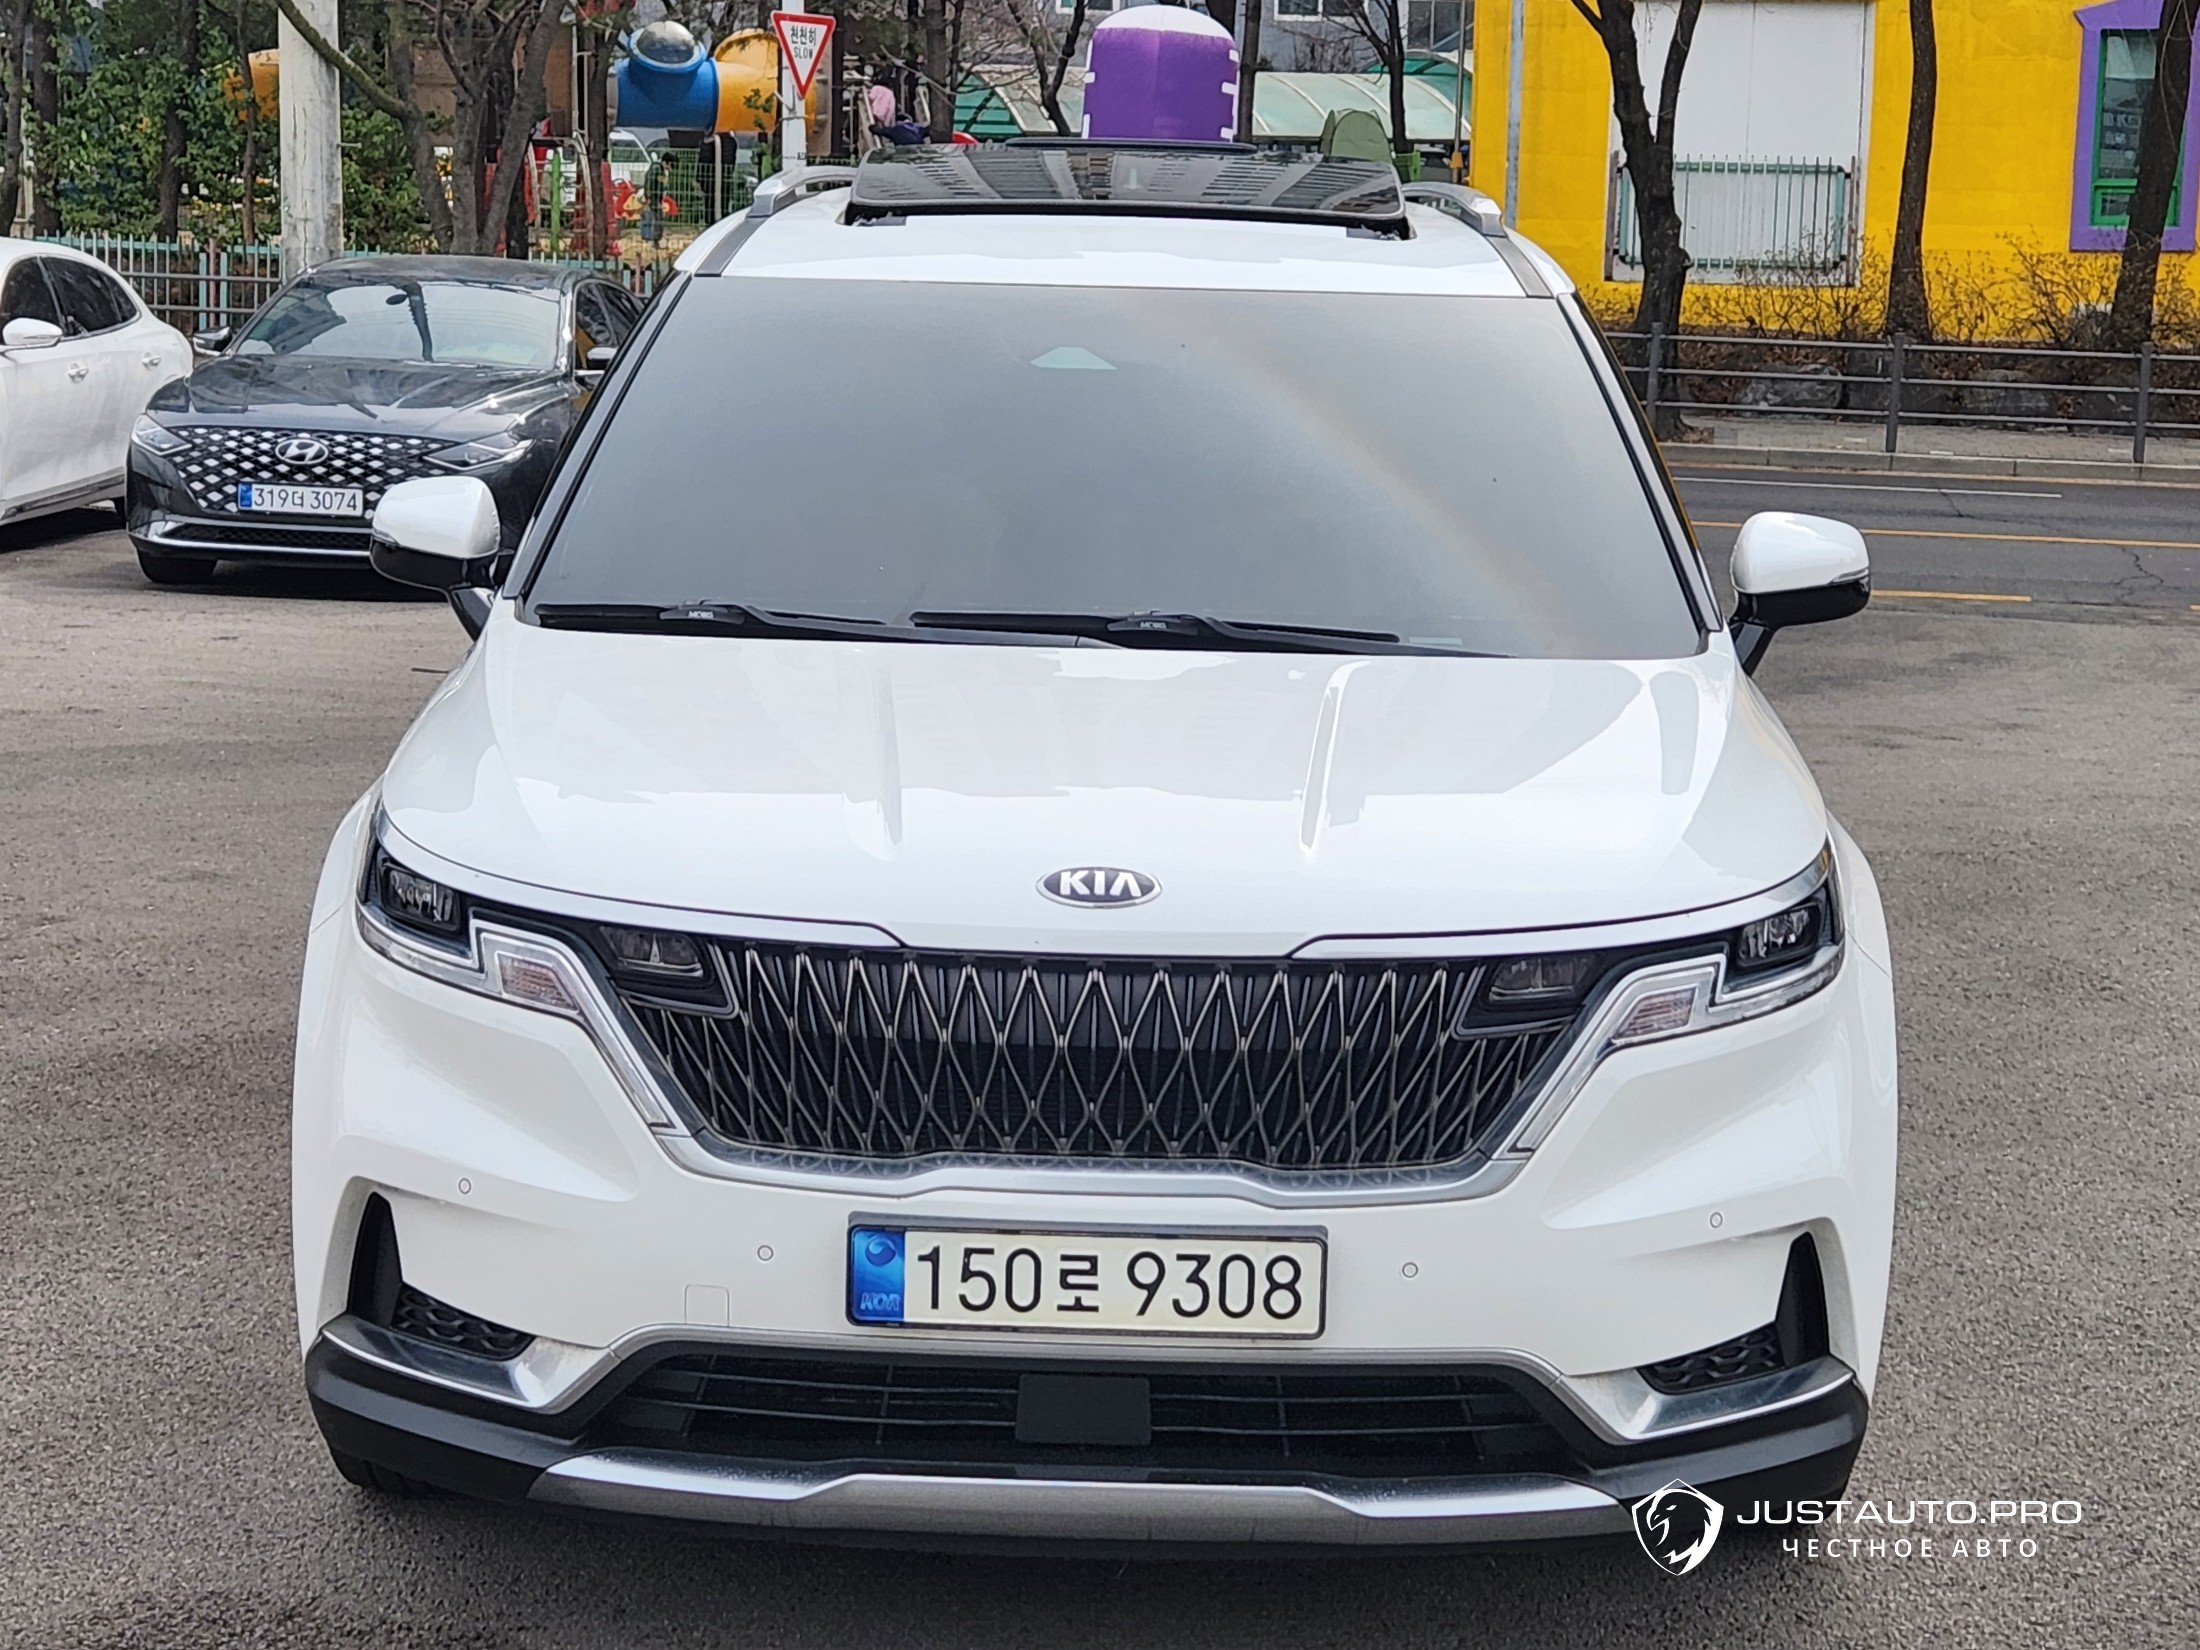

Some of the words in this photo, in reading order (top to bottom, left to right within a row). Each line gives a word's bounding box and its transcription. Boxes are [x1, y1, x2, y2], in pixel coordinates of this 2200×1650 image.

[790, 25, 816, 46] 천천히
[254, 487, 304, 508] 319더
[310, 490, 357, 511] 3074
[1060, 869, 1142, 897] KIA
[917, 1245, 1100, 1313] 150로
[1126, 1251, 1302, 1319] 9308
[860, 1292, 900, 1311] KOR
